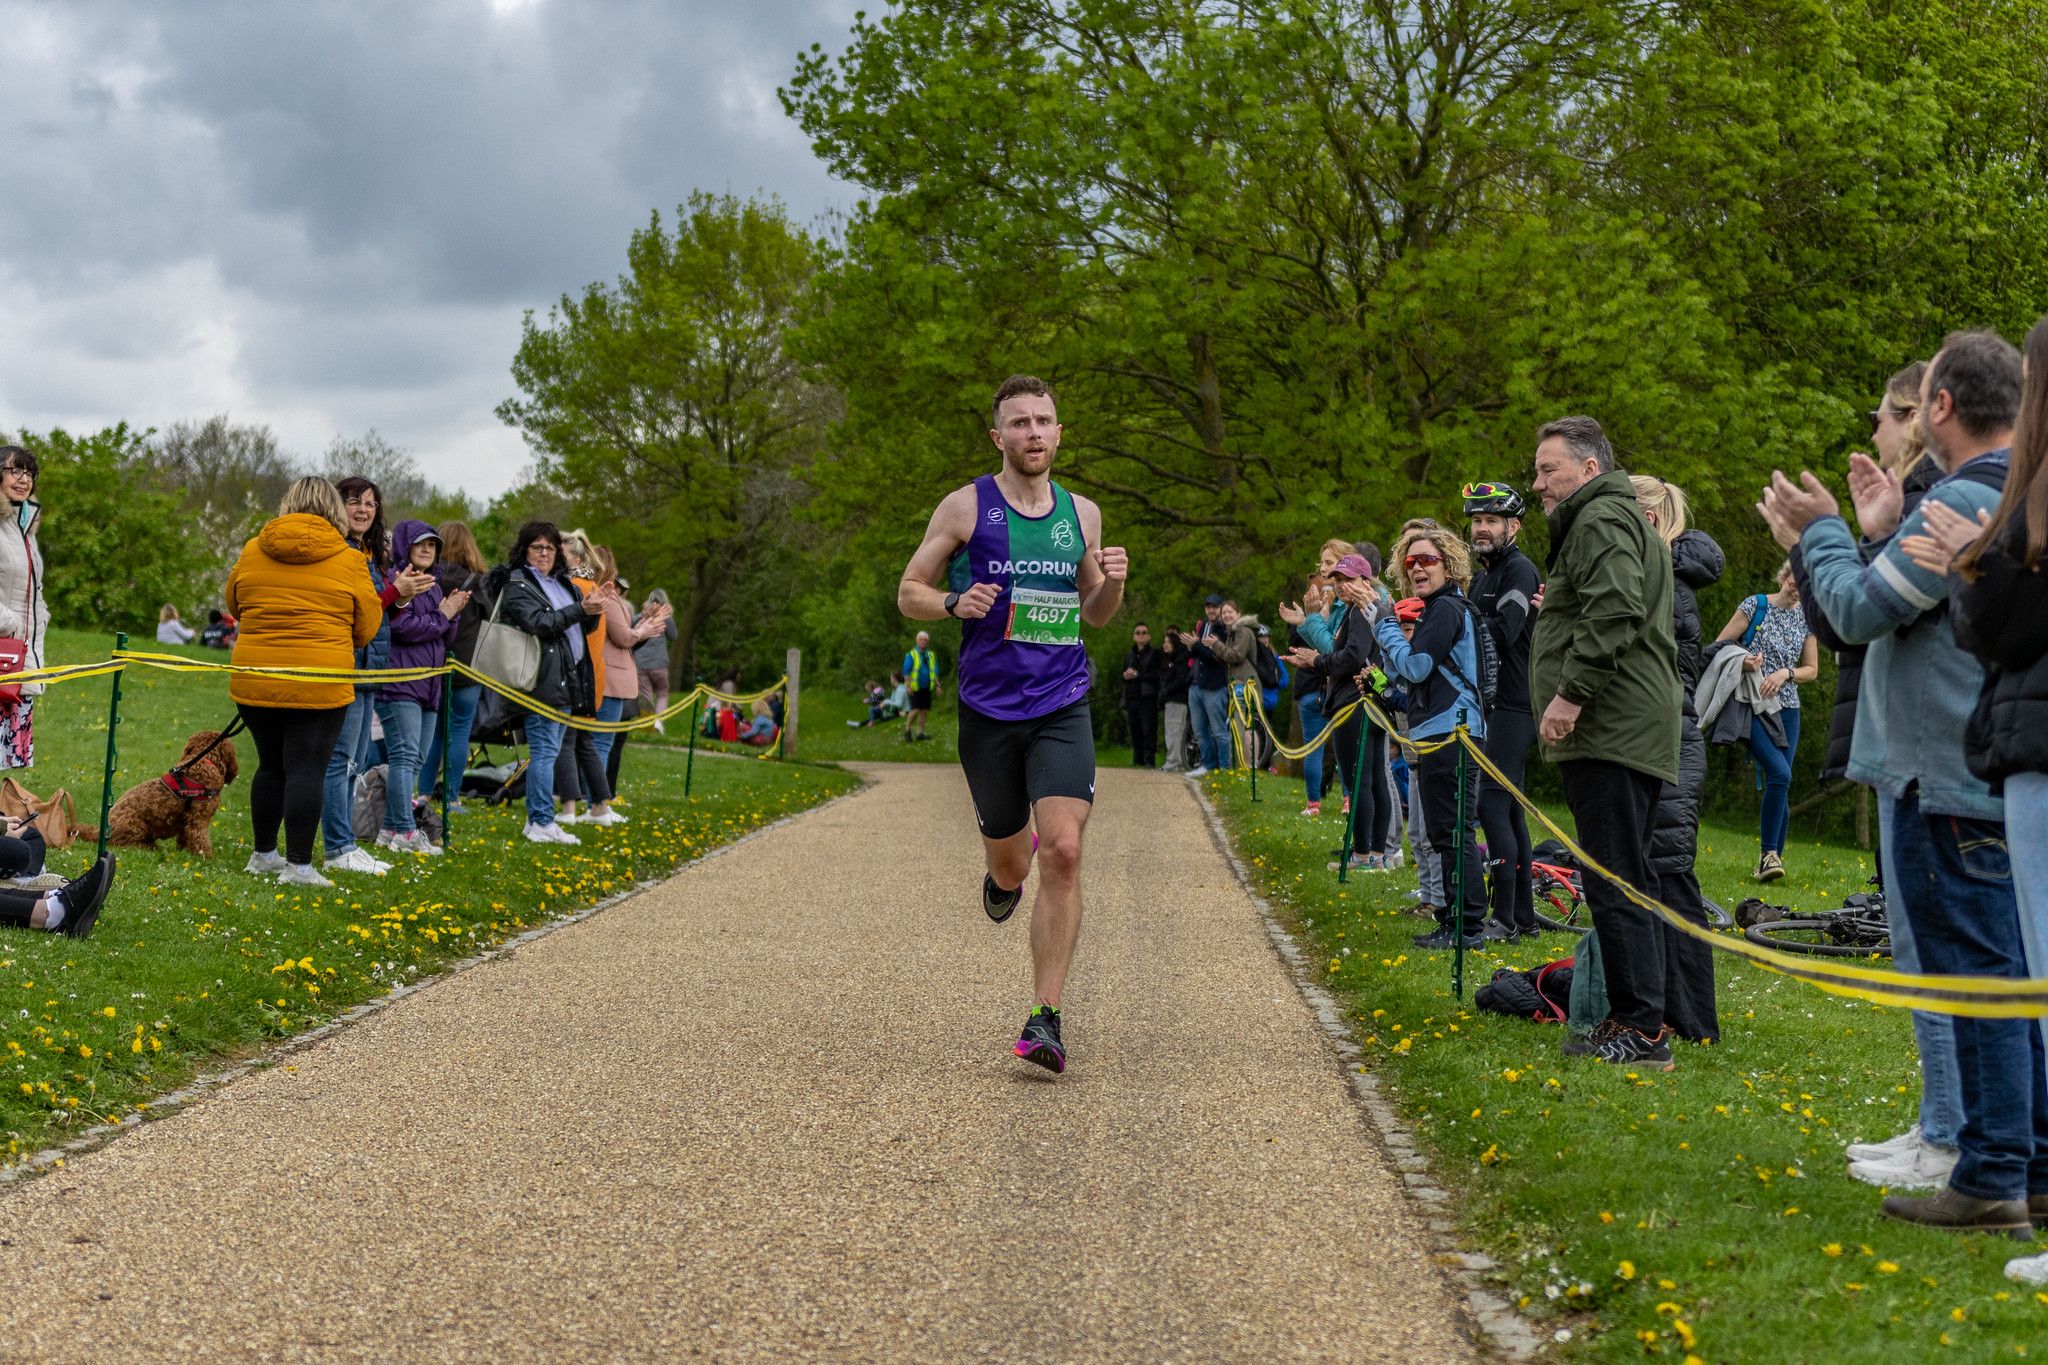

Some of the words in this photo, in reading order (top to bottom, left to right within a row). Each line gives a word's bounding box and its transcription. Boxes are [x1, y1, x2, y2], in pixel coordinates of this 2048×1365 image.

[988, 560, 1077, 577] DACORUM
[1034, 595, 1052, 604] HALF
[1052, 597, 1079, 605] MARATHO
[1026, 607, 1069, 624] 4697
